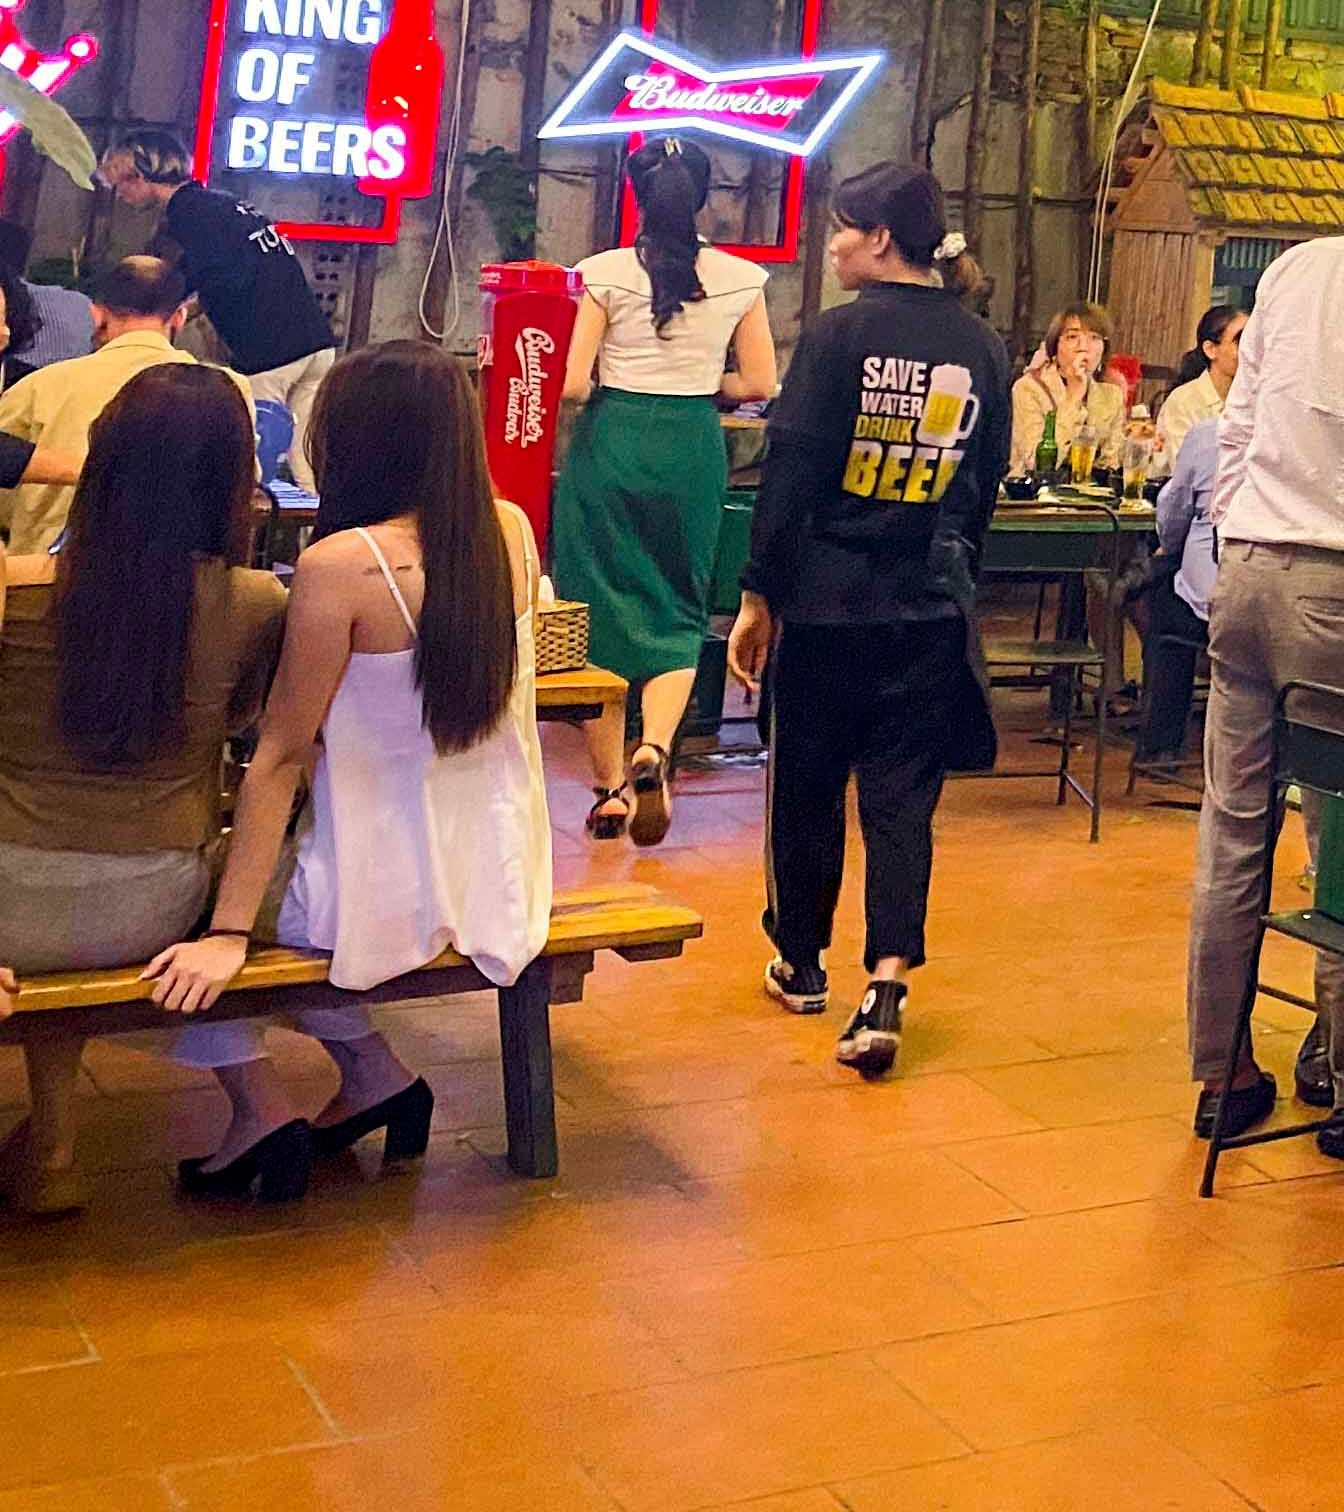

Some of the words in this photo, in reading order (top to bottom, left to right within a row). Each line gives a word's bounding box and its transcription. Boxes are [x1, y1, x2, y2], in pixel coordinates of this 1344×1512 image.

[236, 52, 315, 106] OF
[624, 74, 804, 117] Budweiser
[227, 117, 407, 180] BEERS
[519, 327, 555, 445] Budweiser
[862, 356, 928, 394] SAVE
[861, 390, 925, 418] WATER
[854, 414, 916, 445] DRINK
